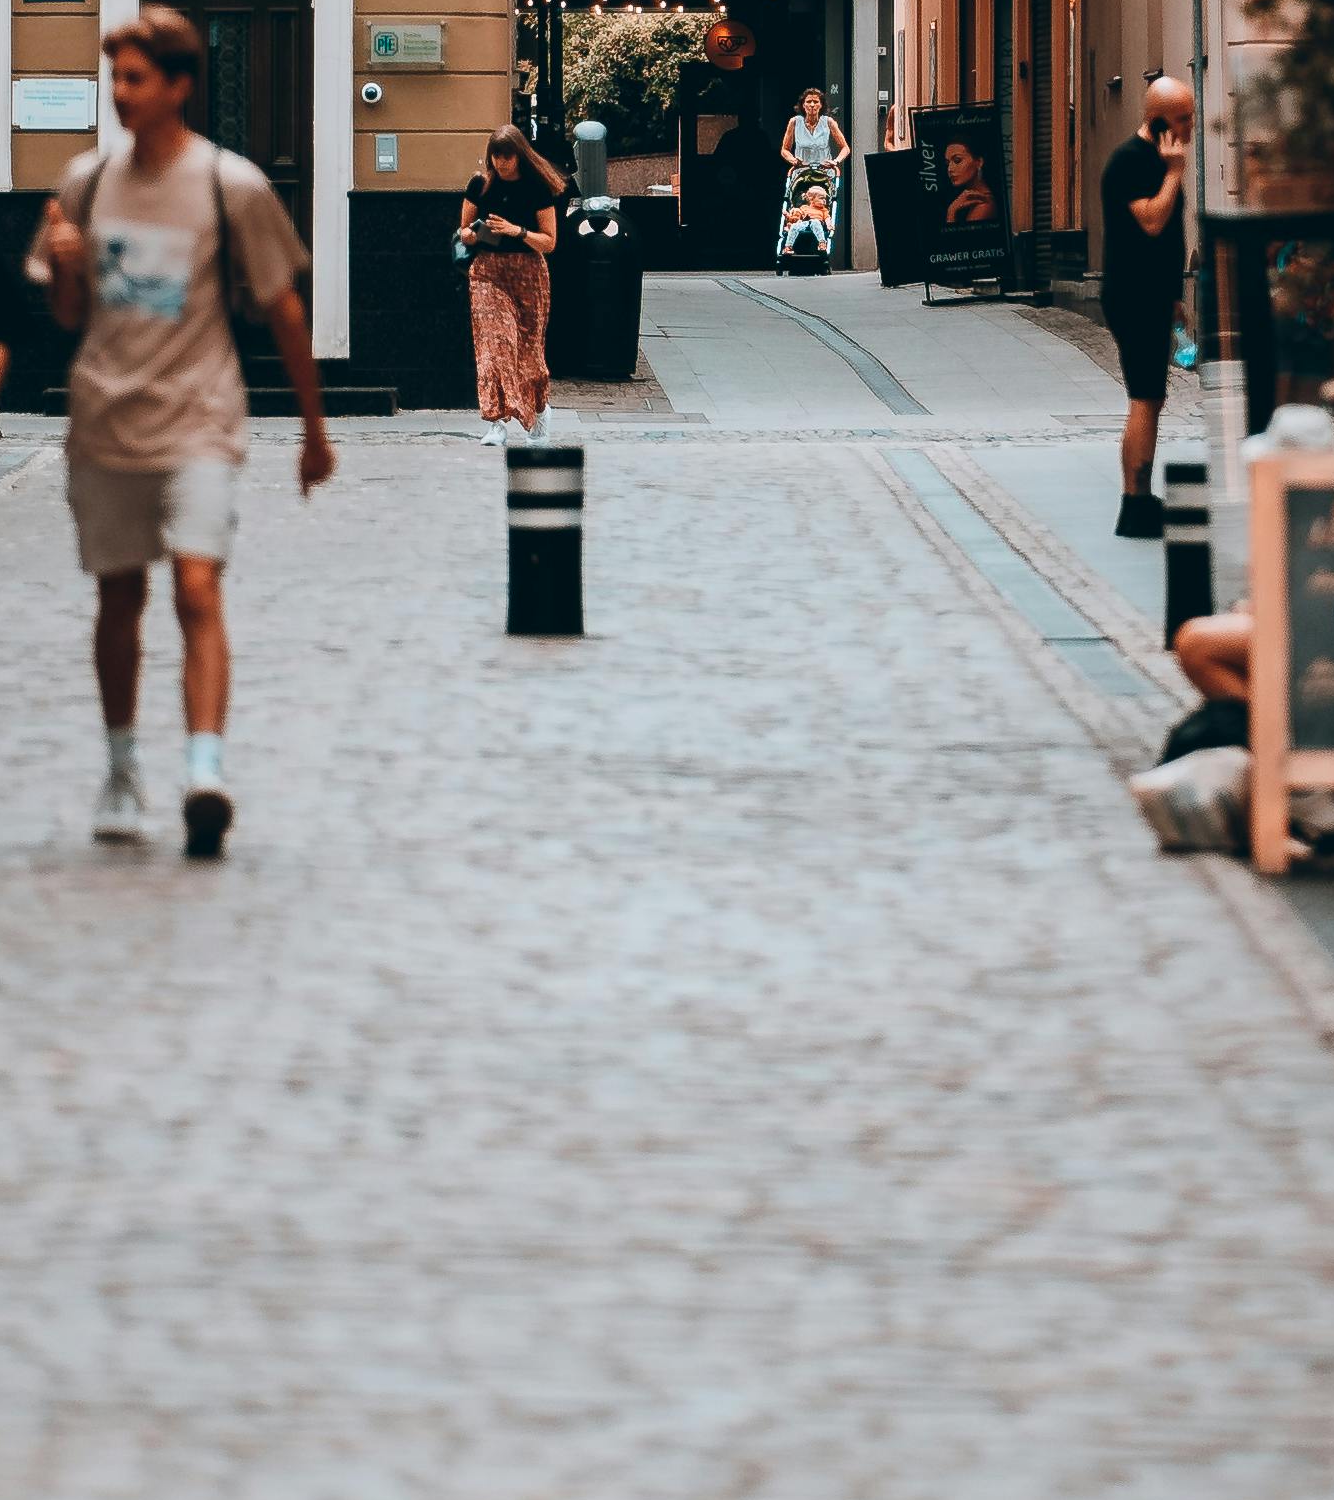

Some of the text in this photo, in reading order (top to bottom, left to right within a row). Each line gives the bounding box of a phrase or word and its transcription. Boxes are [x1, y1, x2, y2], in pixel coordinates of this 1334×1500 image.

[918, 139, 938, 193] silver
[929, 248, 1005, 264] GRAWER GRATIS
